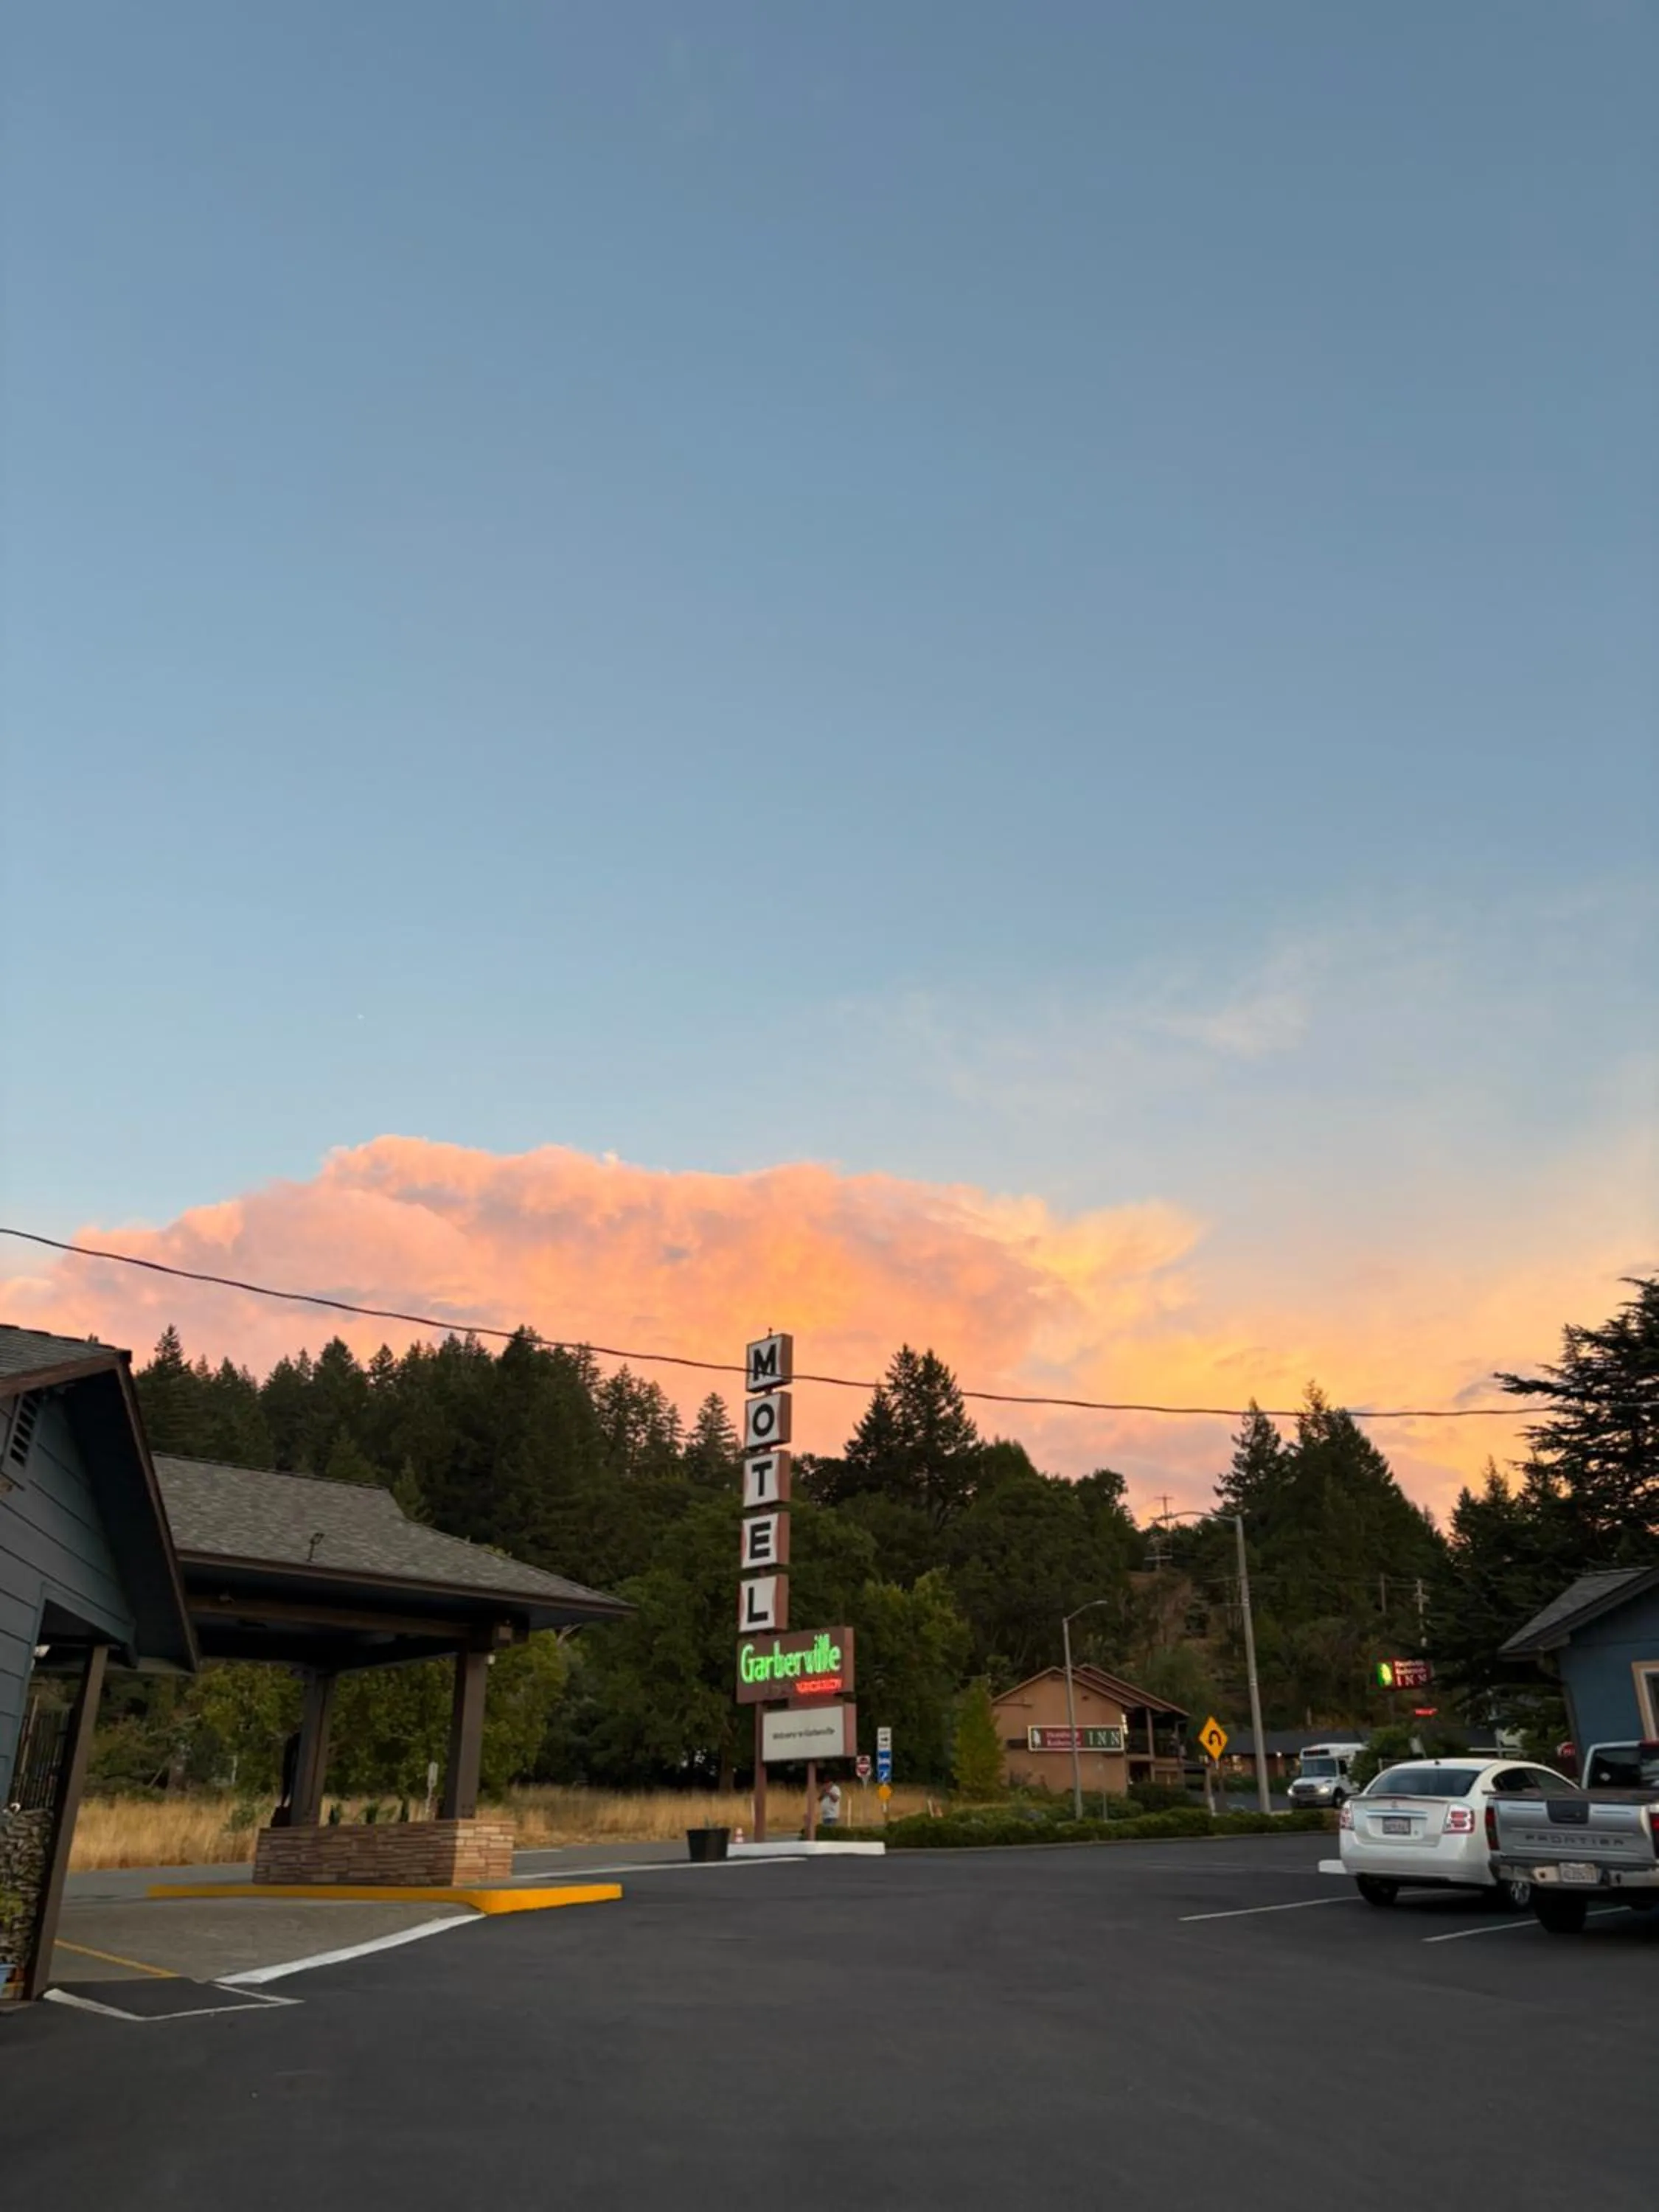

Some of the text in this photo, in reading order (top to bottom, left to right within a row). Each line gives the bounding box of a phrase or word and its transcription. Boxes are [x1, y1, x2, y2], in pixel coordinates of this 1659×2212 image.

[747, 1348, 776, 1623] MOTEL
[740, 1633, 841, 1683] Garberville
[1088, 1731, 1120, 1746] INN
[1525, 1834, 1624, 1845] FRONTIER
